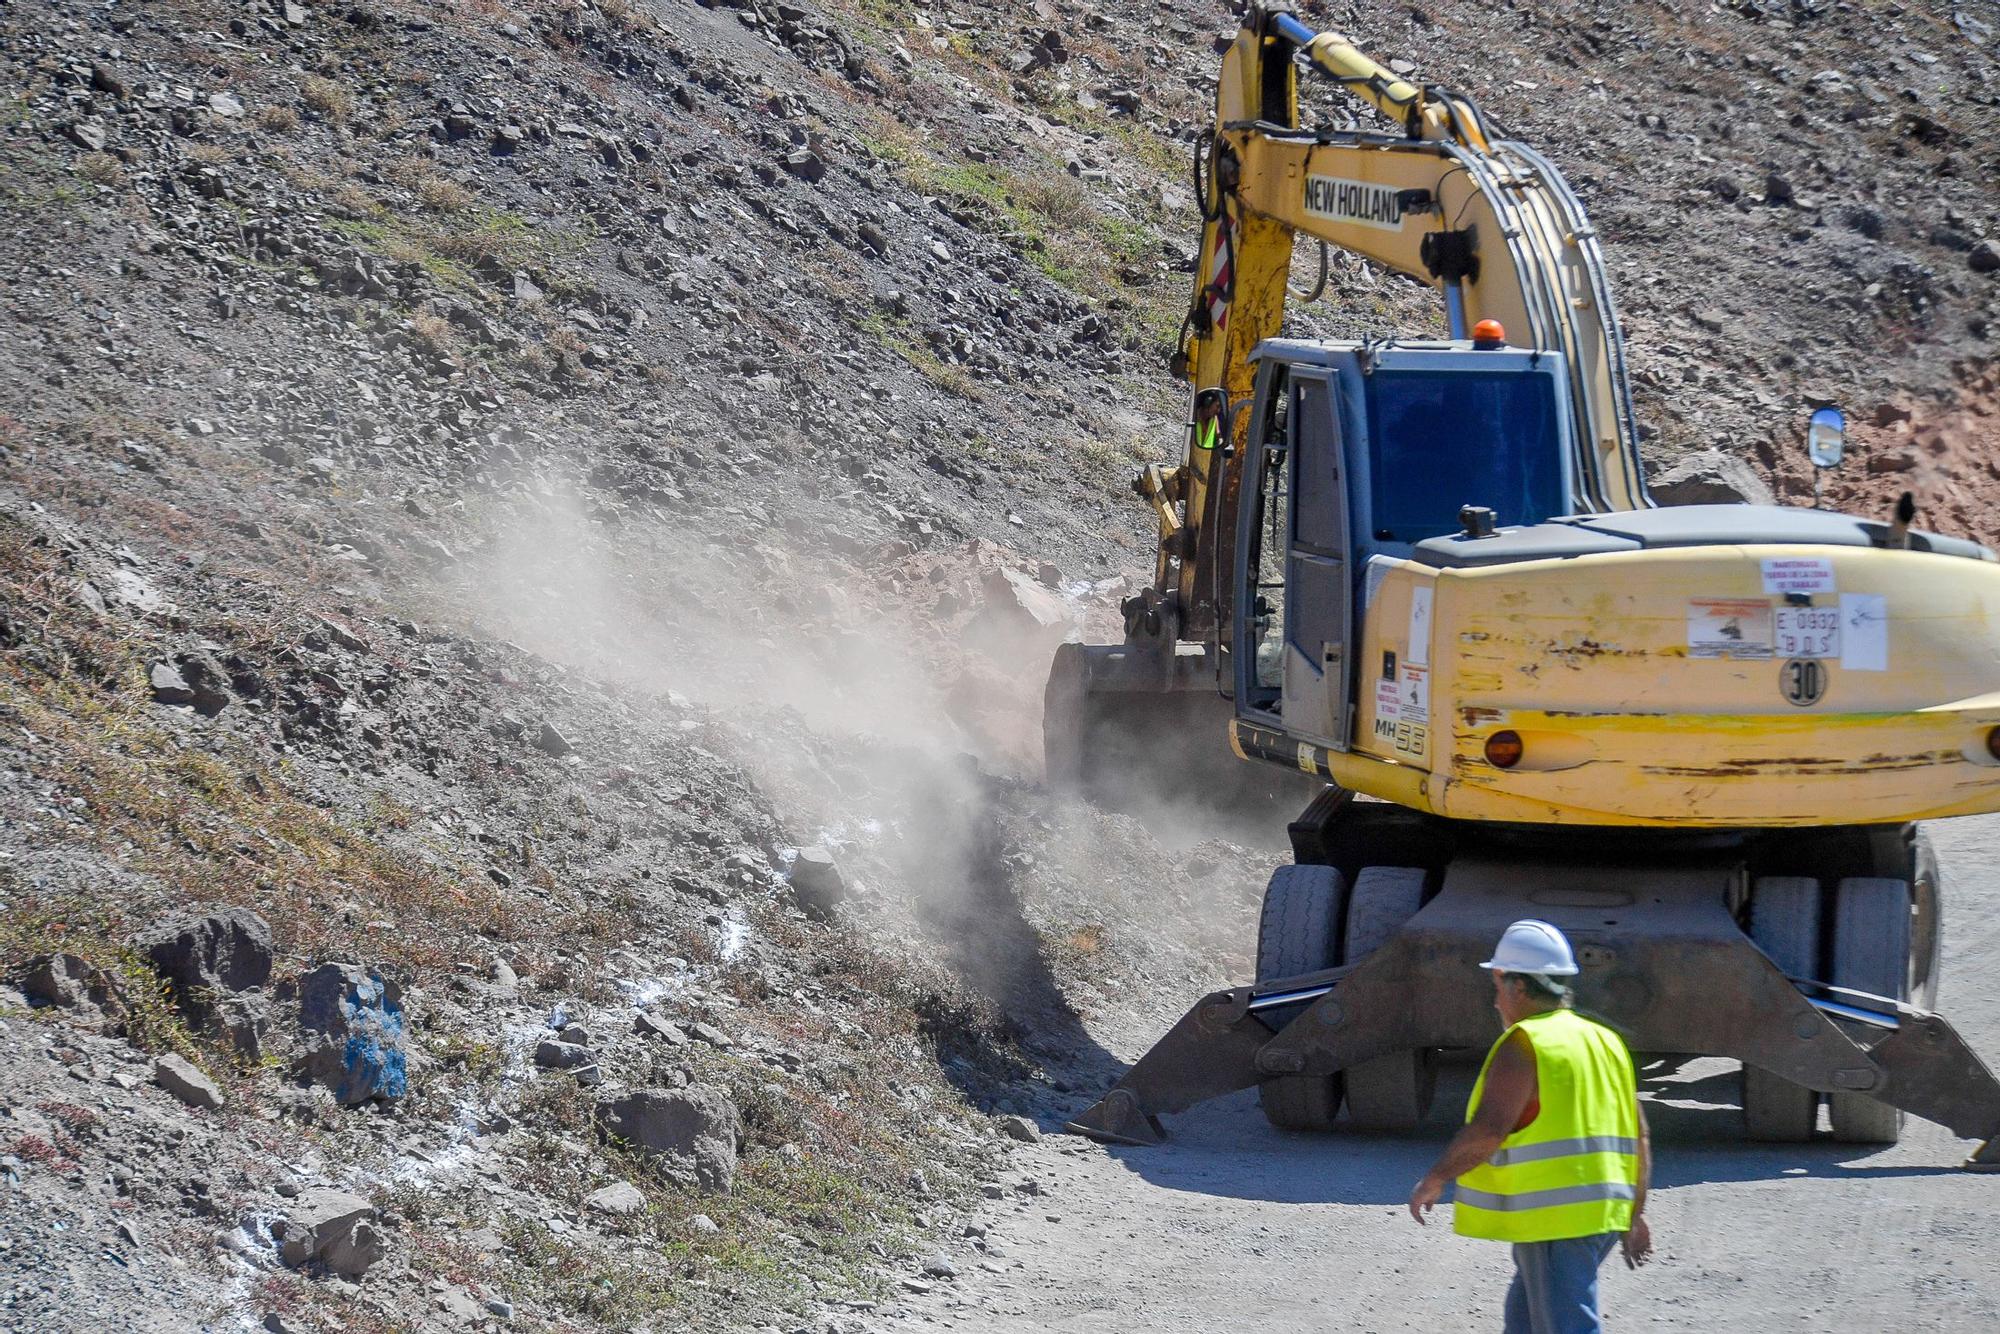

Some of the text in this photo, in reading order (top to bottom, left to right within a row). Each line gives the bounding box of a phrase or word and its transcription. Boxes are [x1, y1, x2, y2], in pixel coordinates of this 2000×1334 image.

[1304, 177, 1401, 225] NEW HOLLAND
[1790, 661, 1818, 700] 30
